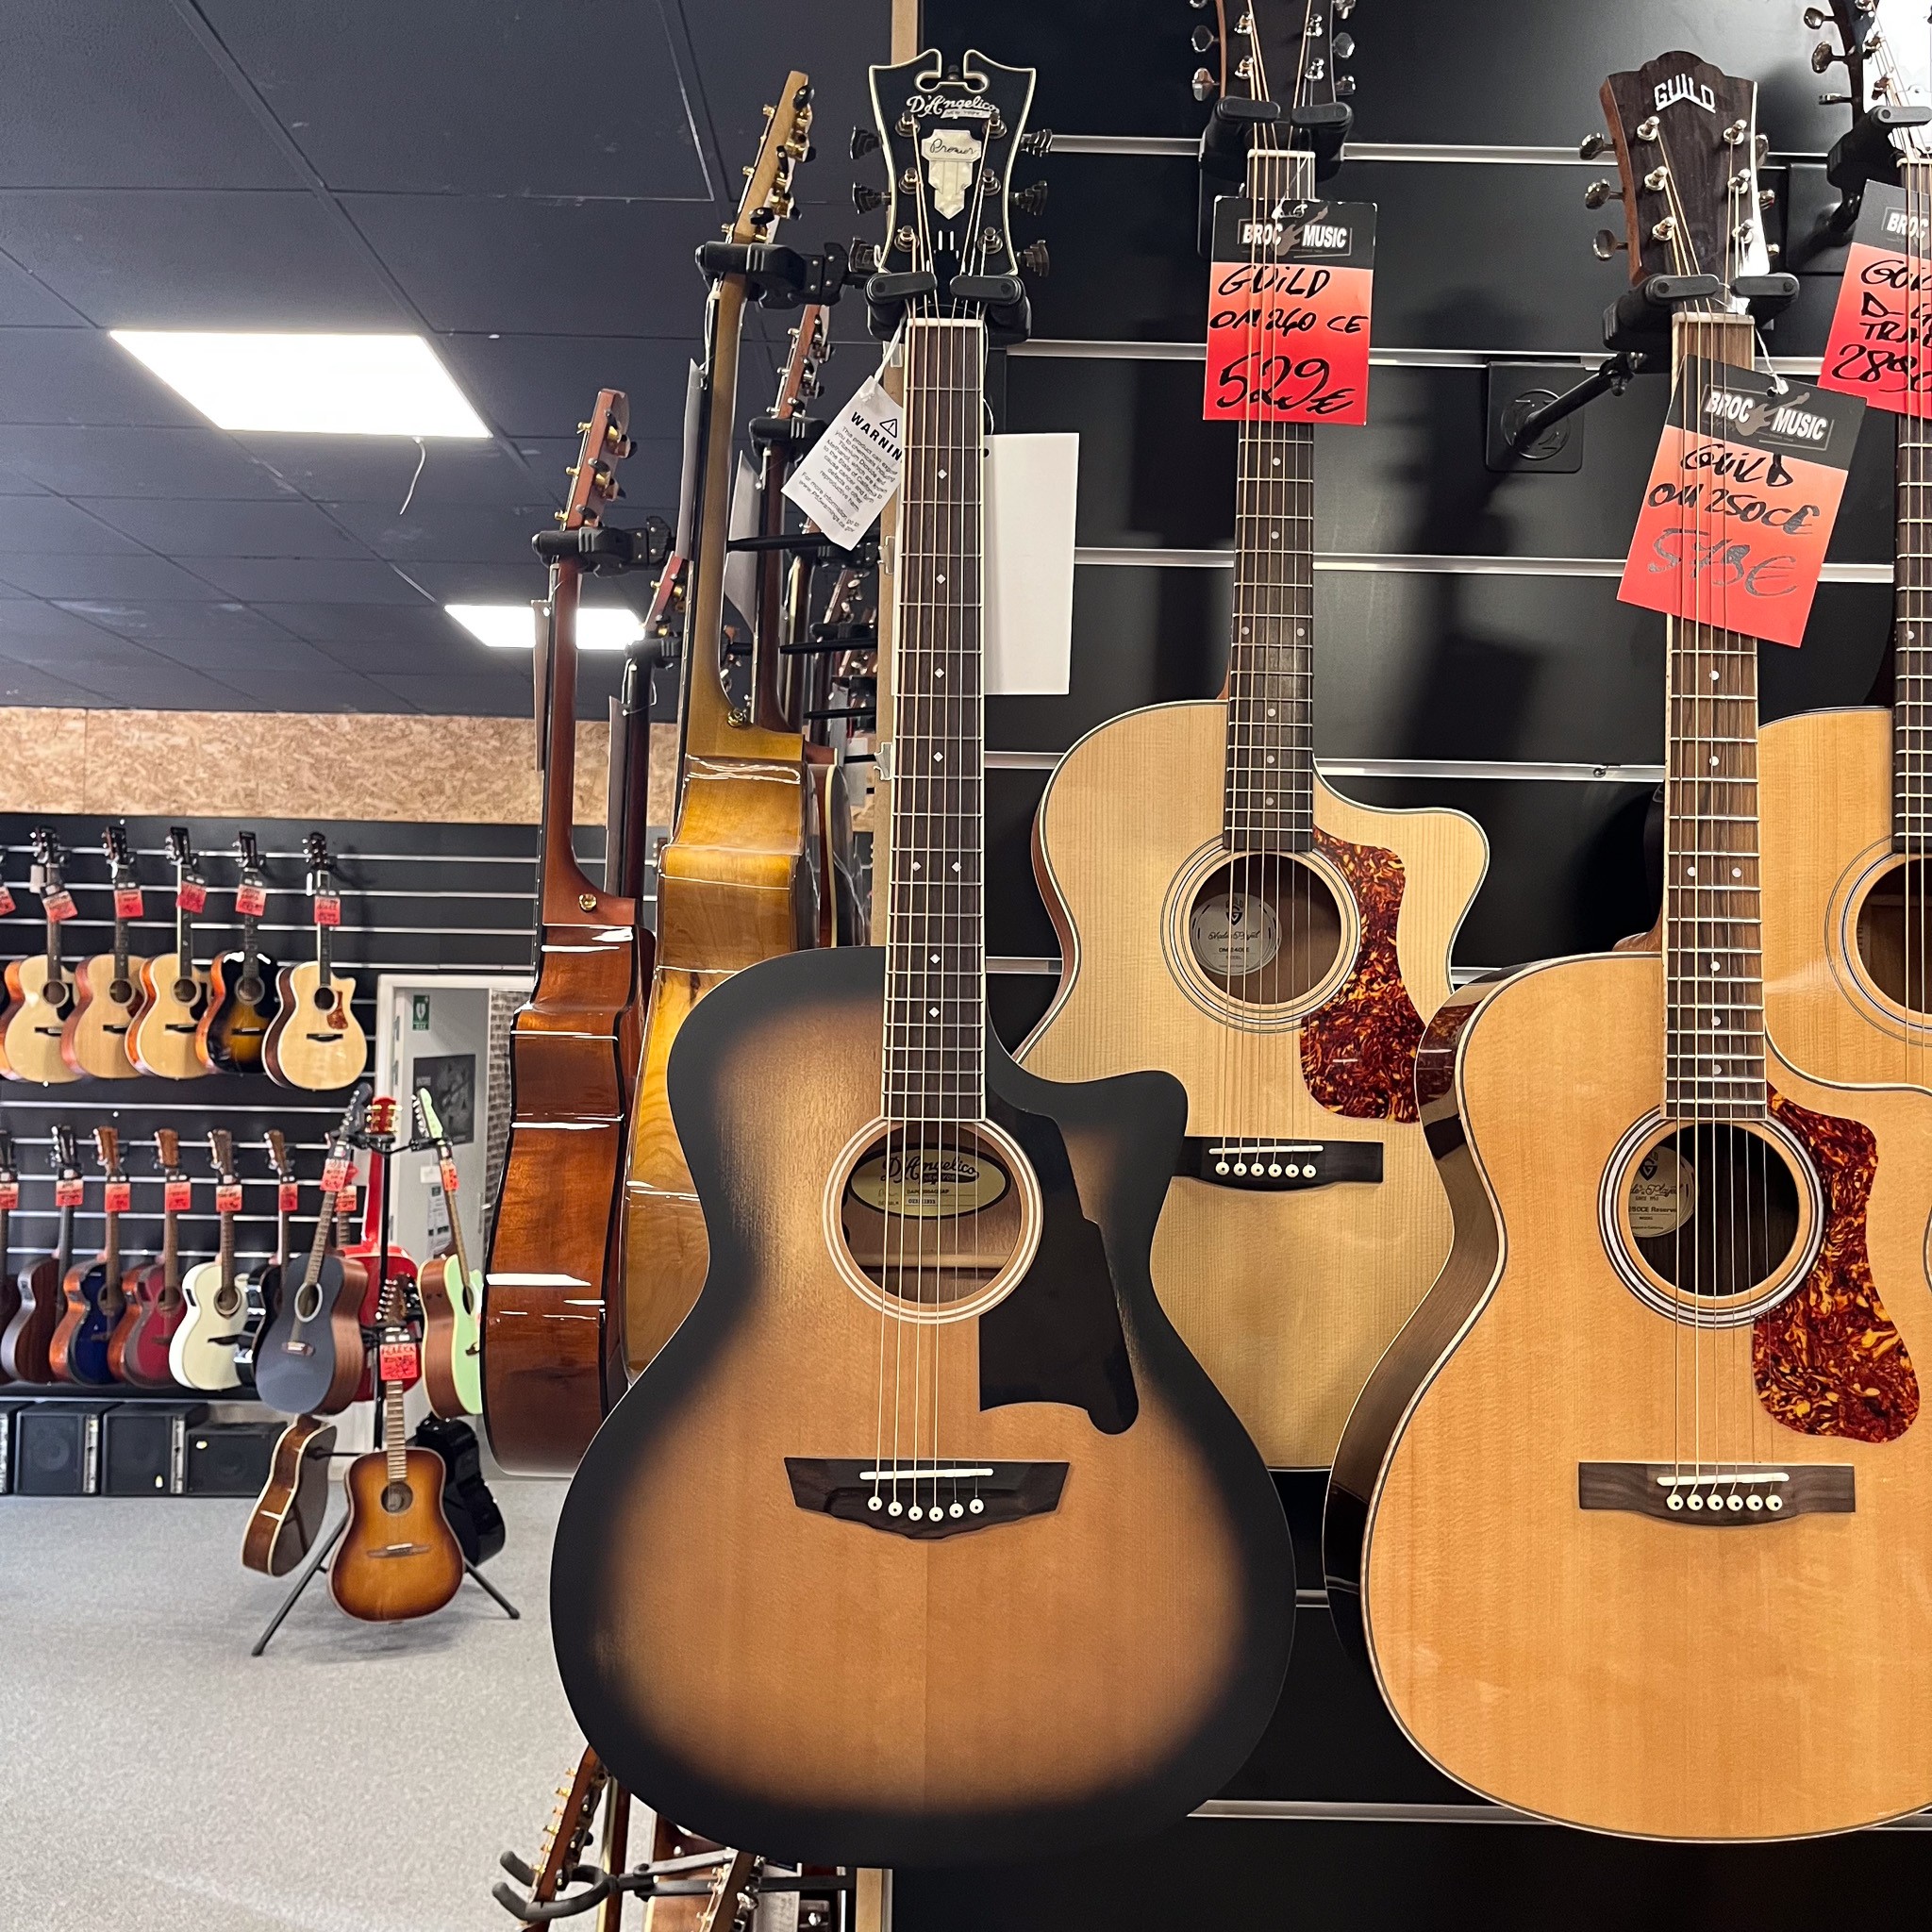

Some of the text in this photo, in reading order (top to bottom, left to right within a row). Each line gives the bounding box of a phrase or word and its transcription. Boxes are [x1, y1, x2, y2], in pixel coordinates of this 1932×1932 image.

[906, 94, 1000, 118] D'Angelico
[1654, 73, 1716, 114] GUILD
[1242, 224, 1347, 248] BROC MUSIC
[1886, 211, 1929, 239] BROC
[1326, 315, 1369, 333] CE
[1706, 391, 1828, 441] BROC MUSIC
[851, 411, 903, 461] WARNIN
